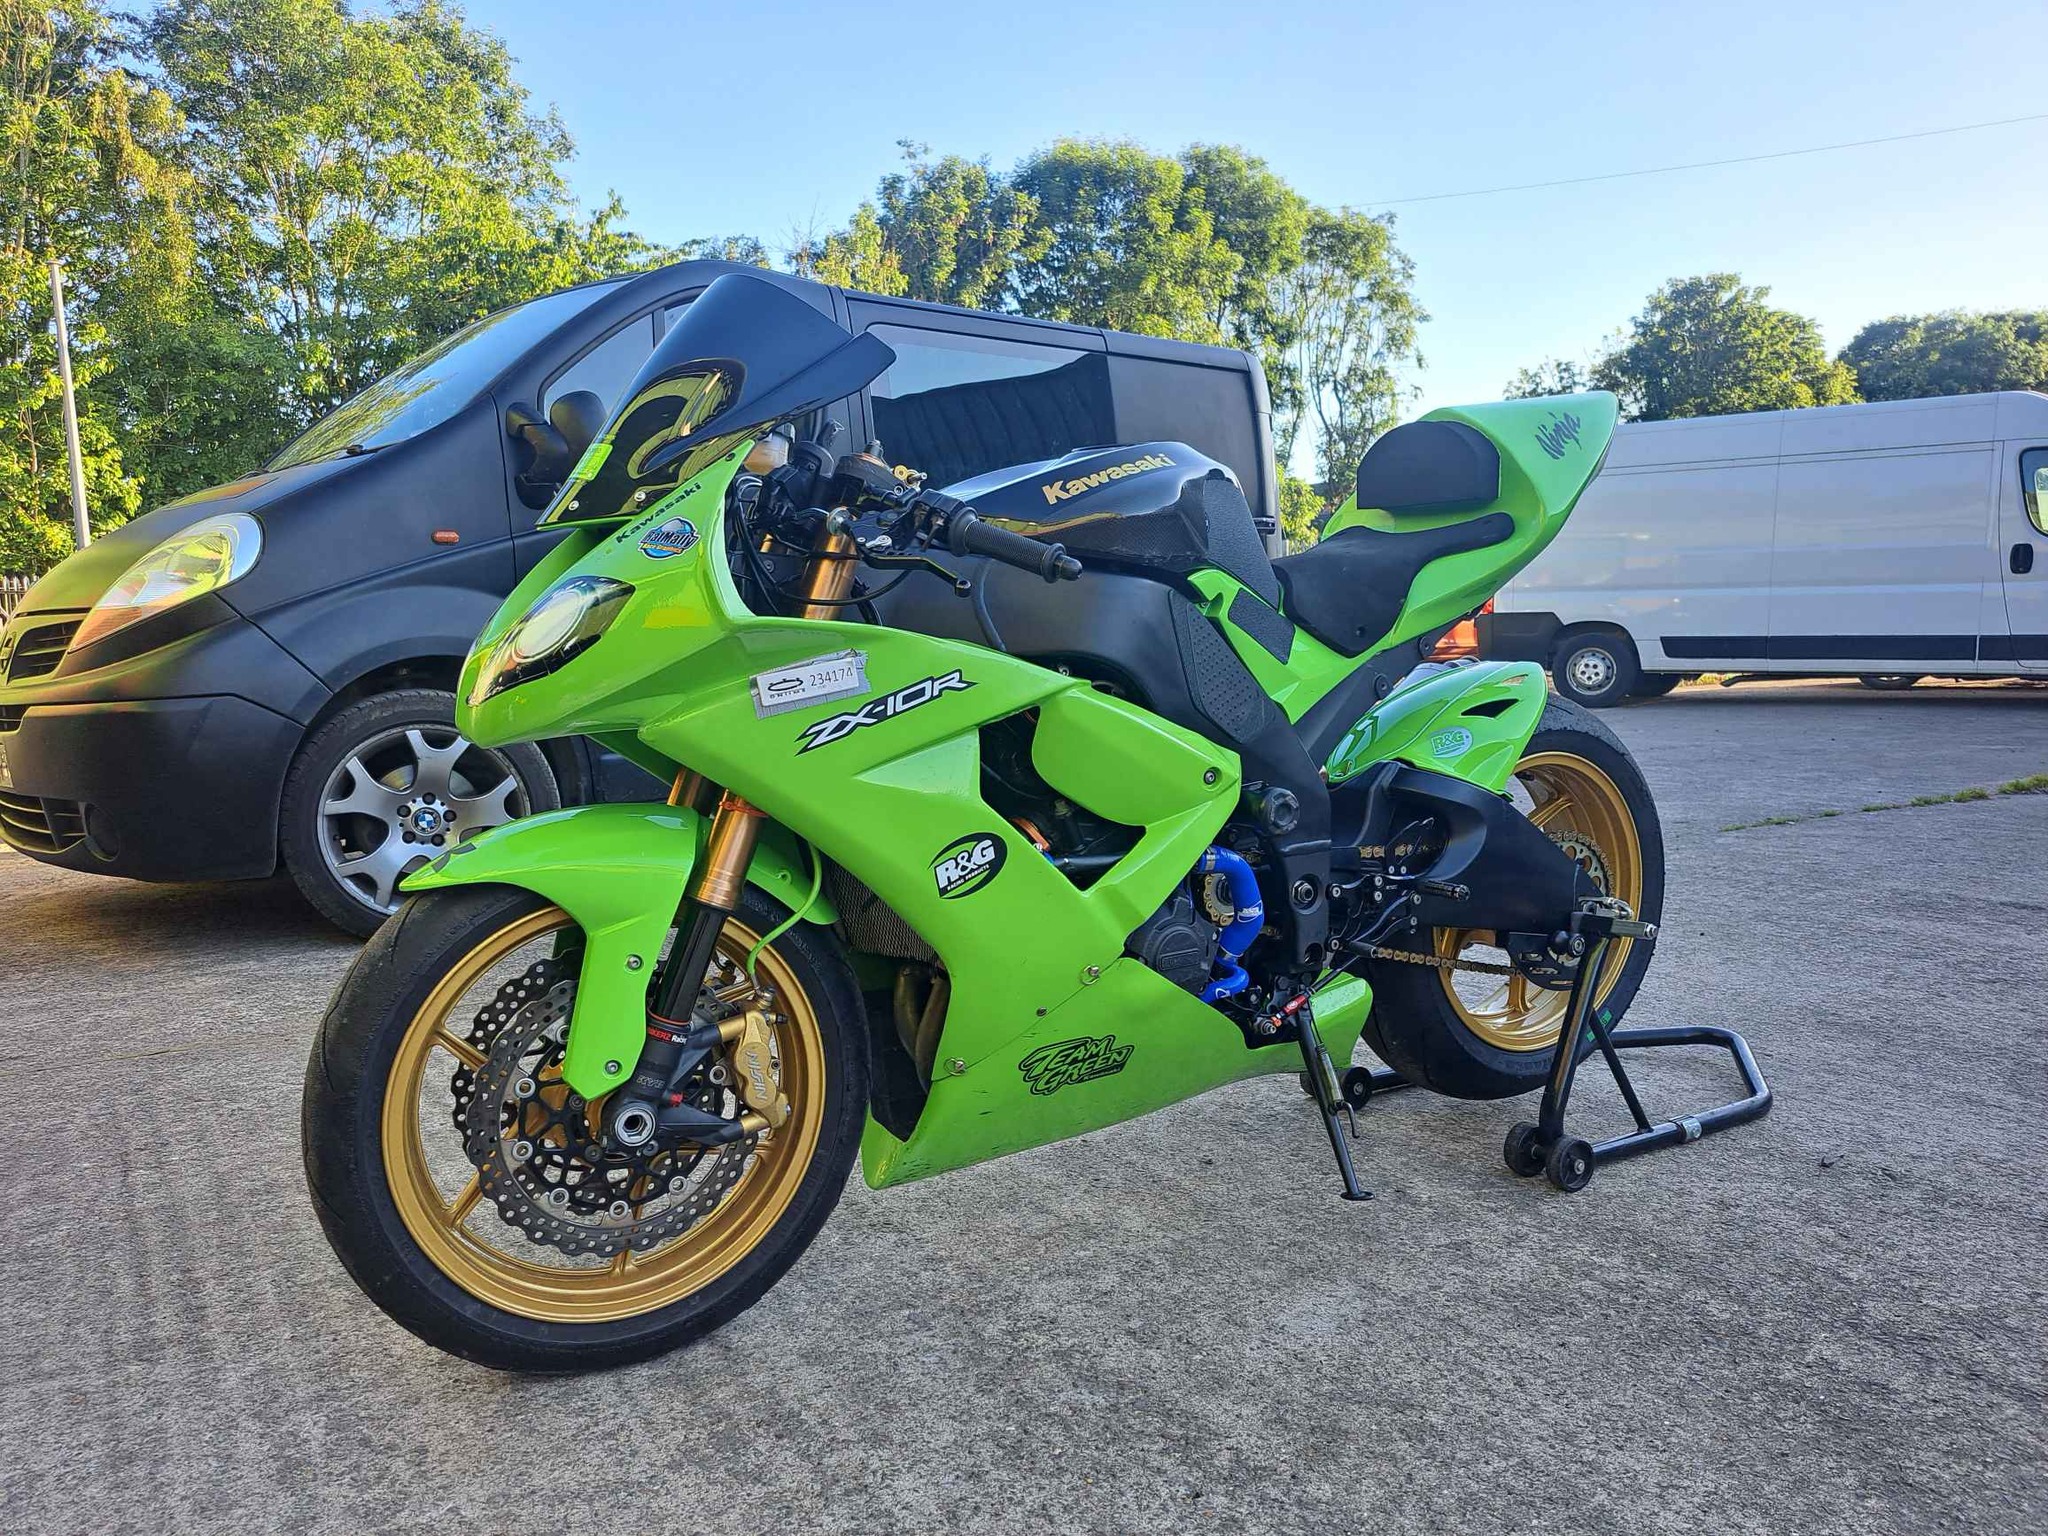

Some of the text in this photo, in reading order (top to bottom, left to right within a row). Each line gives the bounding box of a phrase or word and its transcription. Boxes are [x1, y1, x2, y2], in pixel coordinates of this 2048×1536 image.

[1535, 412, 1582, 460] Ninja
[1042, 453, 1177, 505] Kawasaki
[616, 482, 702, 543] Kawasaki
[809, 667, 854, 688] 234174
[804, 671, 969, 750] ZX-10R
[1432, 731, 1465, 749] R&G
[935, 839, 995, 889] R&G
[1022, 1037, 1112, 1080] TEAM
[1035, 1047, 1131, 1092] GREEN
